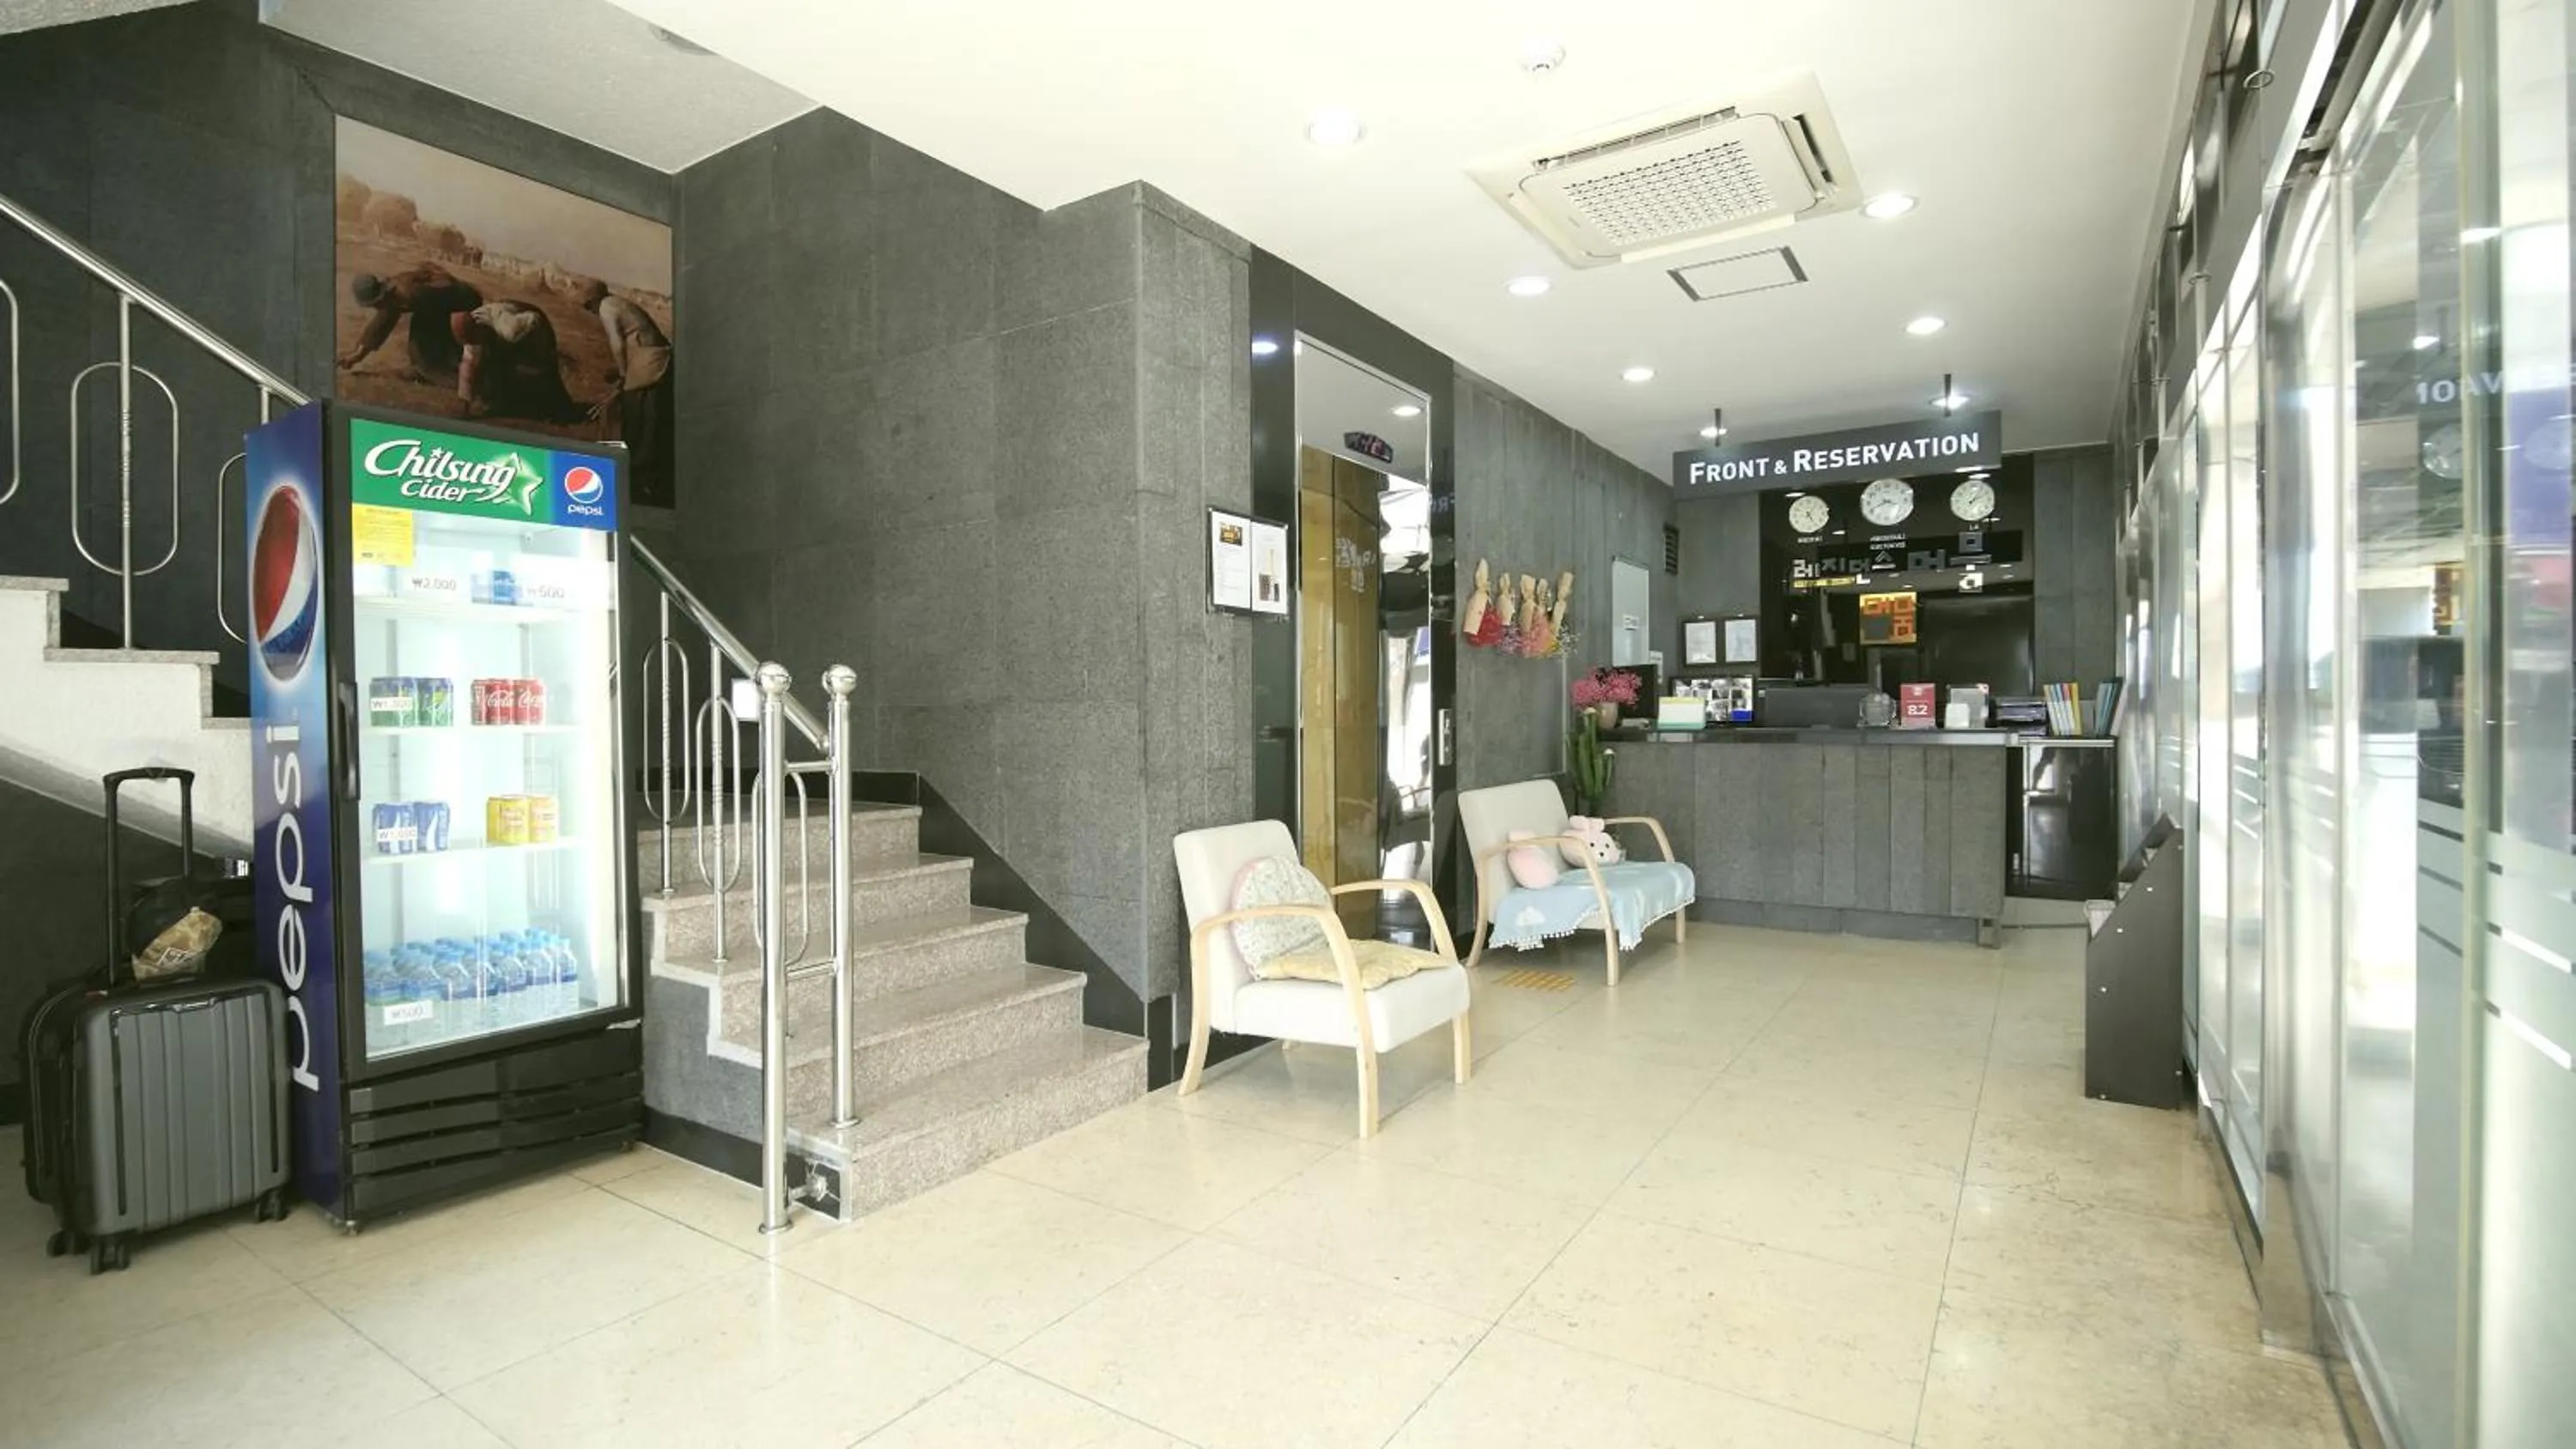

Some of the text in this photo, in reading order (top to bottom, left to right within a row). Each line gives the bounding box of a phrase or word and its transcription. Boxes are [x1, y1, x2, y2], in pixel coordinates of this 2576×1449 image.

[364, 439, 516, 502] Chilsung
[1689, 432, 1979, 485] FRONT & RESERVATION
[400, 479, 486, 503] Cider
[567, 504, 605, 517] pepsi
[266, 725, 319, 1093] pepsi
